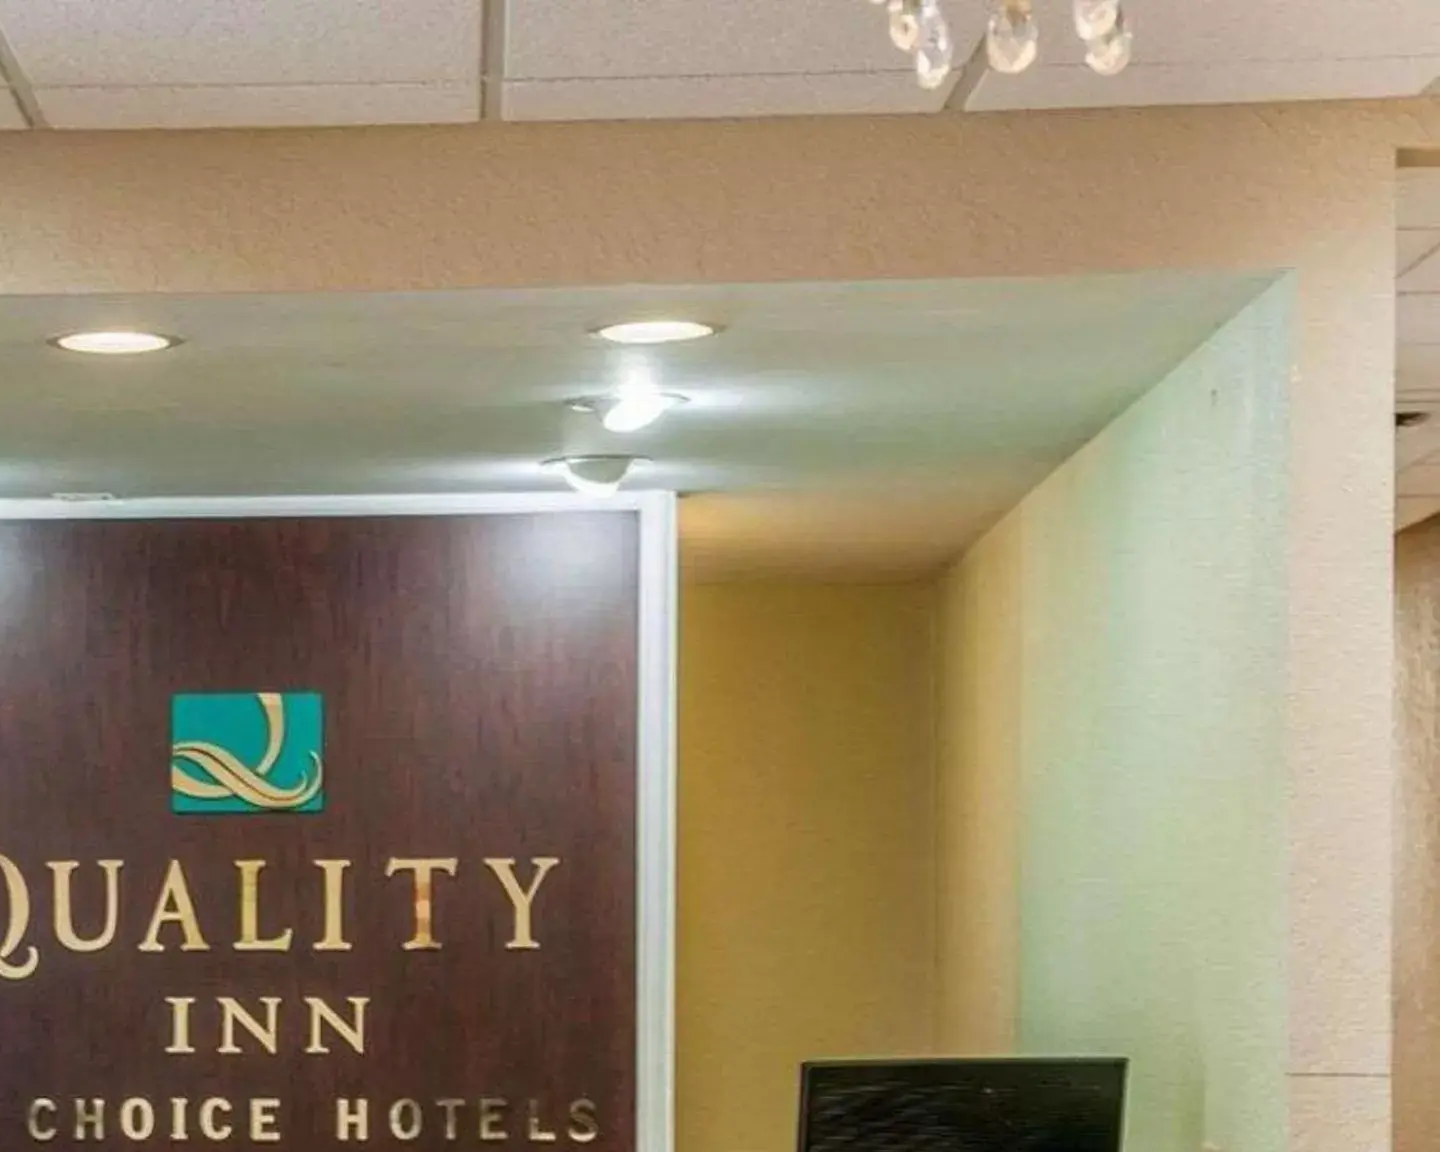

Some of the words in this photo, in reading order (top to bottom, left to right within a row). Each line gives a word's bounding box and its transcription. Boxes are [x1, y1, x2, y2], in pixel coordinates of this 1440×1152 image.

[165, 997, 370, 1054] INN
[27, 1097, 281, 1142] CHOICE
[337, 1097, 601, 1143] HOTELS
